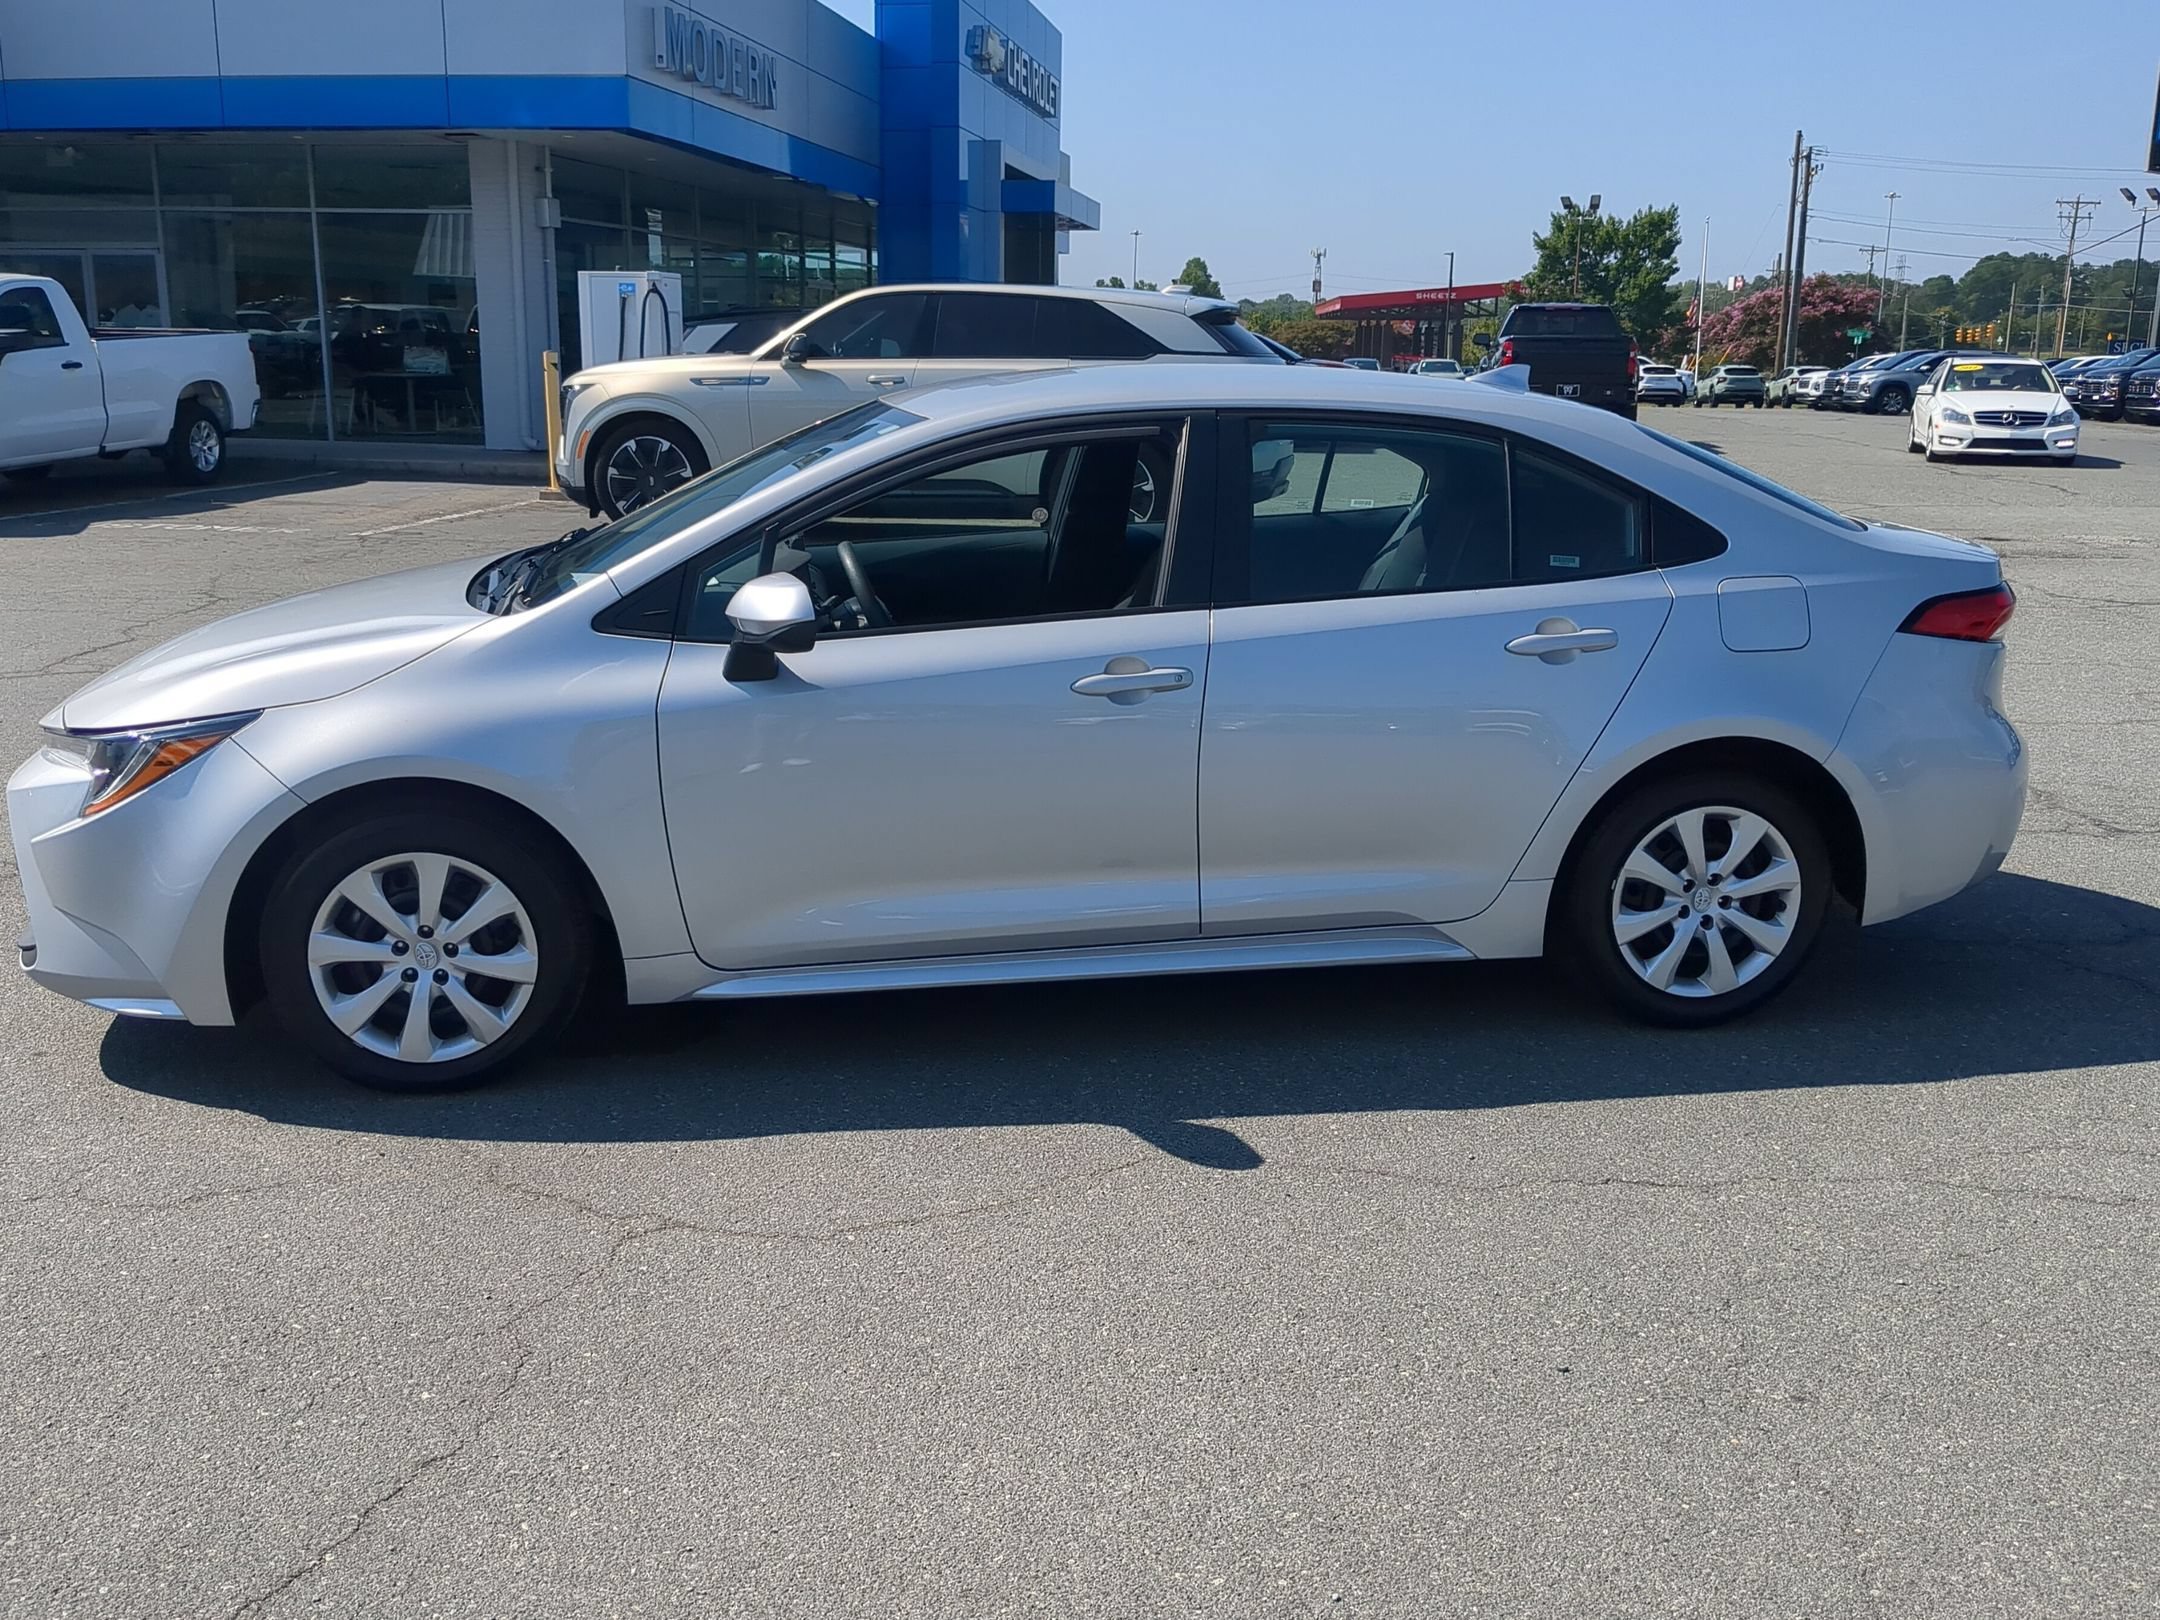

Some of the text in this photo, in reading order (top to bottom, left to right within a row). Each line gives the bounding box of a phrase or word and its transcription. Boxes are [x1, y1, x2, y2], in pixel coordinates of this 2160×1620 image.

[656, 6, 777, 110] MODERN
[1007, 40, 1060, 116] CHEVROLET
[1415, 292, 1457, 300] SHEETZ
